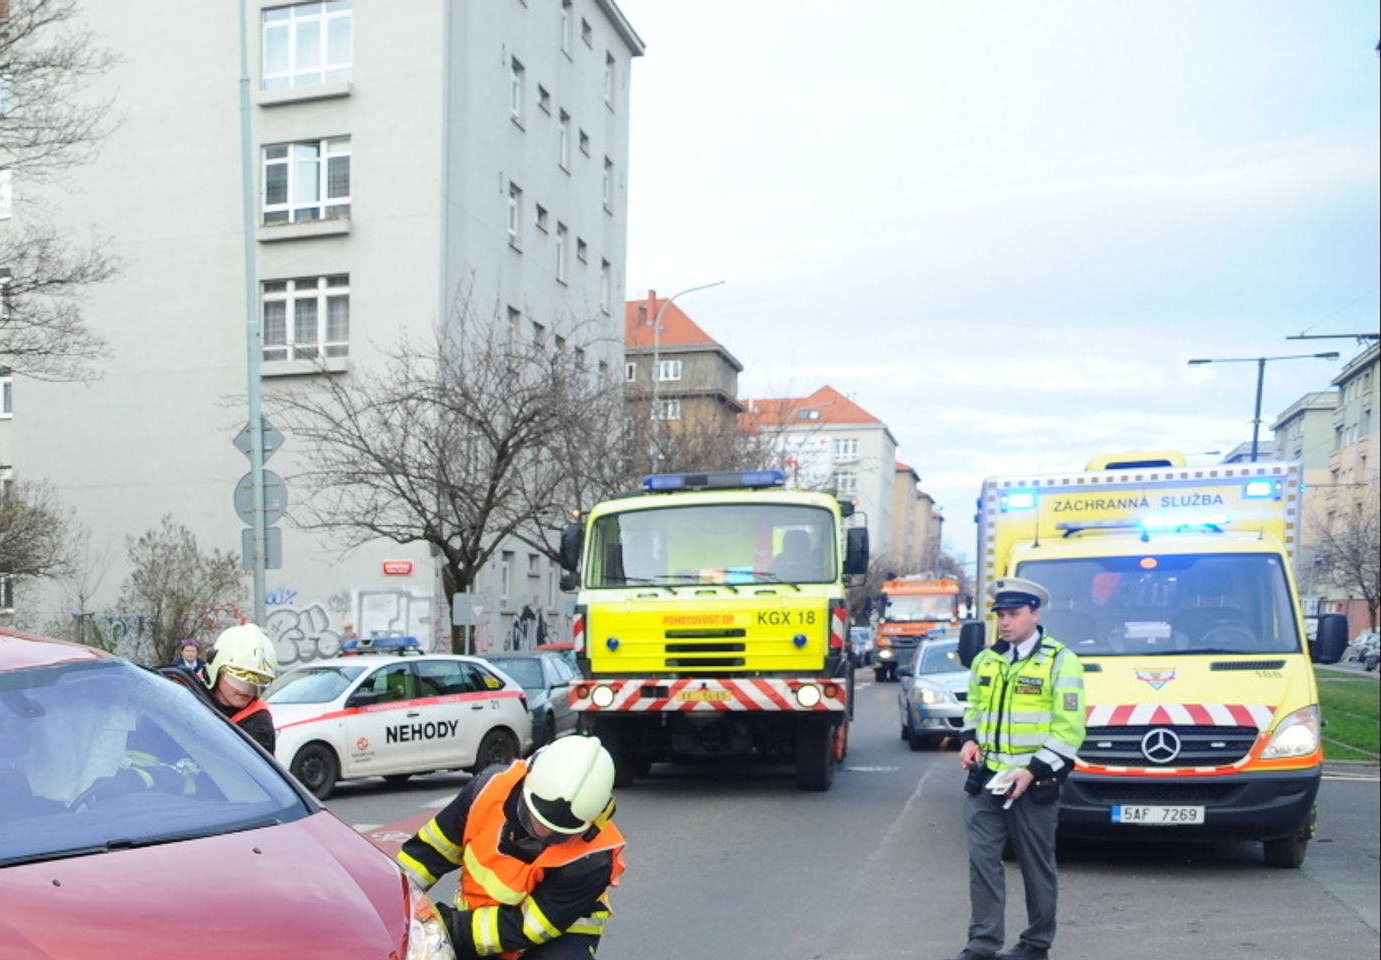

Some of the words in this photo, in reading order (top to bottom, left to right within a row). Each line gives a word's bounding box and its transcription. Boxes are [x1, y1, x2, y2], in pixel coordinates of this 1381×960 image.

[1161, 492, 1224, 507] SLUŽBA
[758, 611, 791, 625] KGX
[798, 611, 816, 625] 18
[386, 719, 459, 744] NEHODY
[1124, 807, 1151, 821] 5AF
[1162, 808, 1198, 821] 7269
